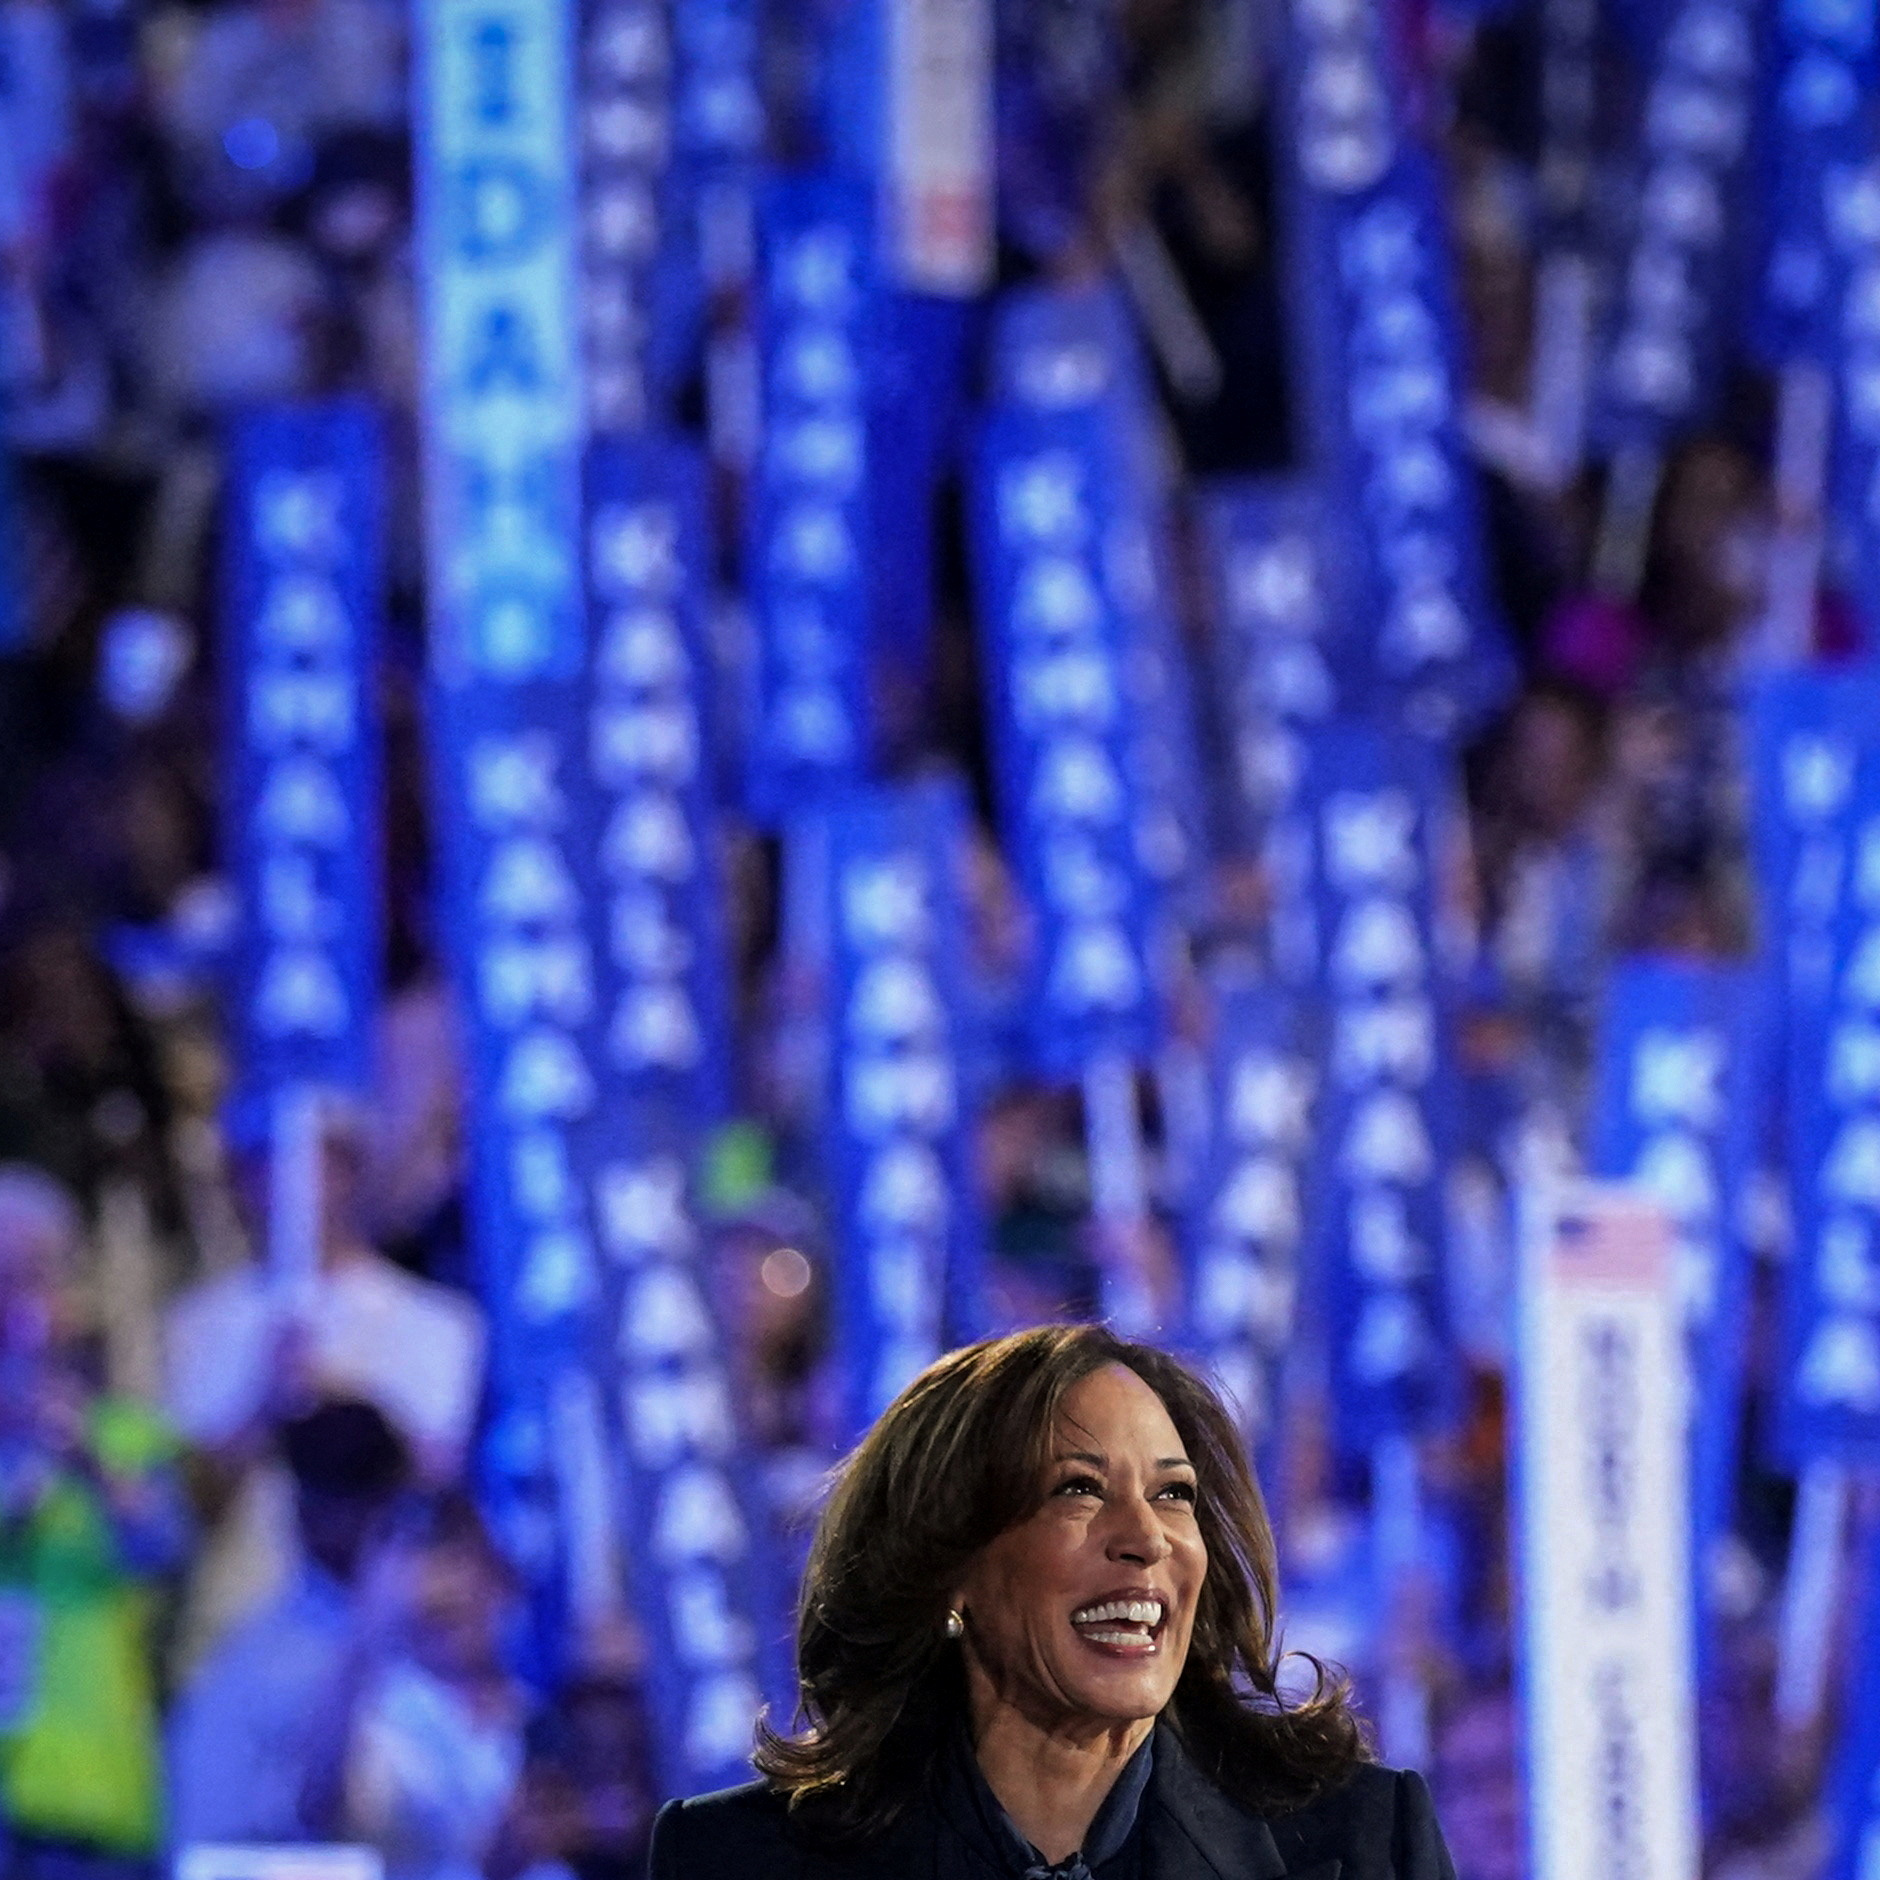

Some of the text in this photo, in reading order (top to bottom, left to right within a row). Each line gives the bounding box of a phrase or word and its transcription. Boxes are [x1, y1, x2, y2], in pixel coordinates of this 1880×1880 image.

[250, 470, 368, 1037] KAMALA
[588, 508, 702, 1072] KAMALA
[993, 455, 1140, 1012] KAMALA
[465, 732, 595, 1318] KAMALA
[1328, 792, 1438, 1390] KAMALA
[592, 1157, 762, 1778] KAMALA
